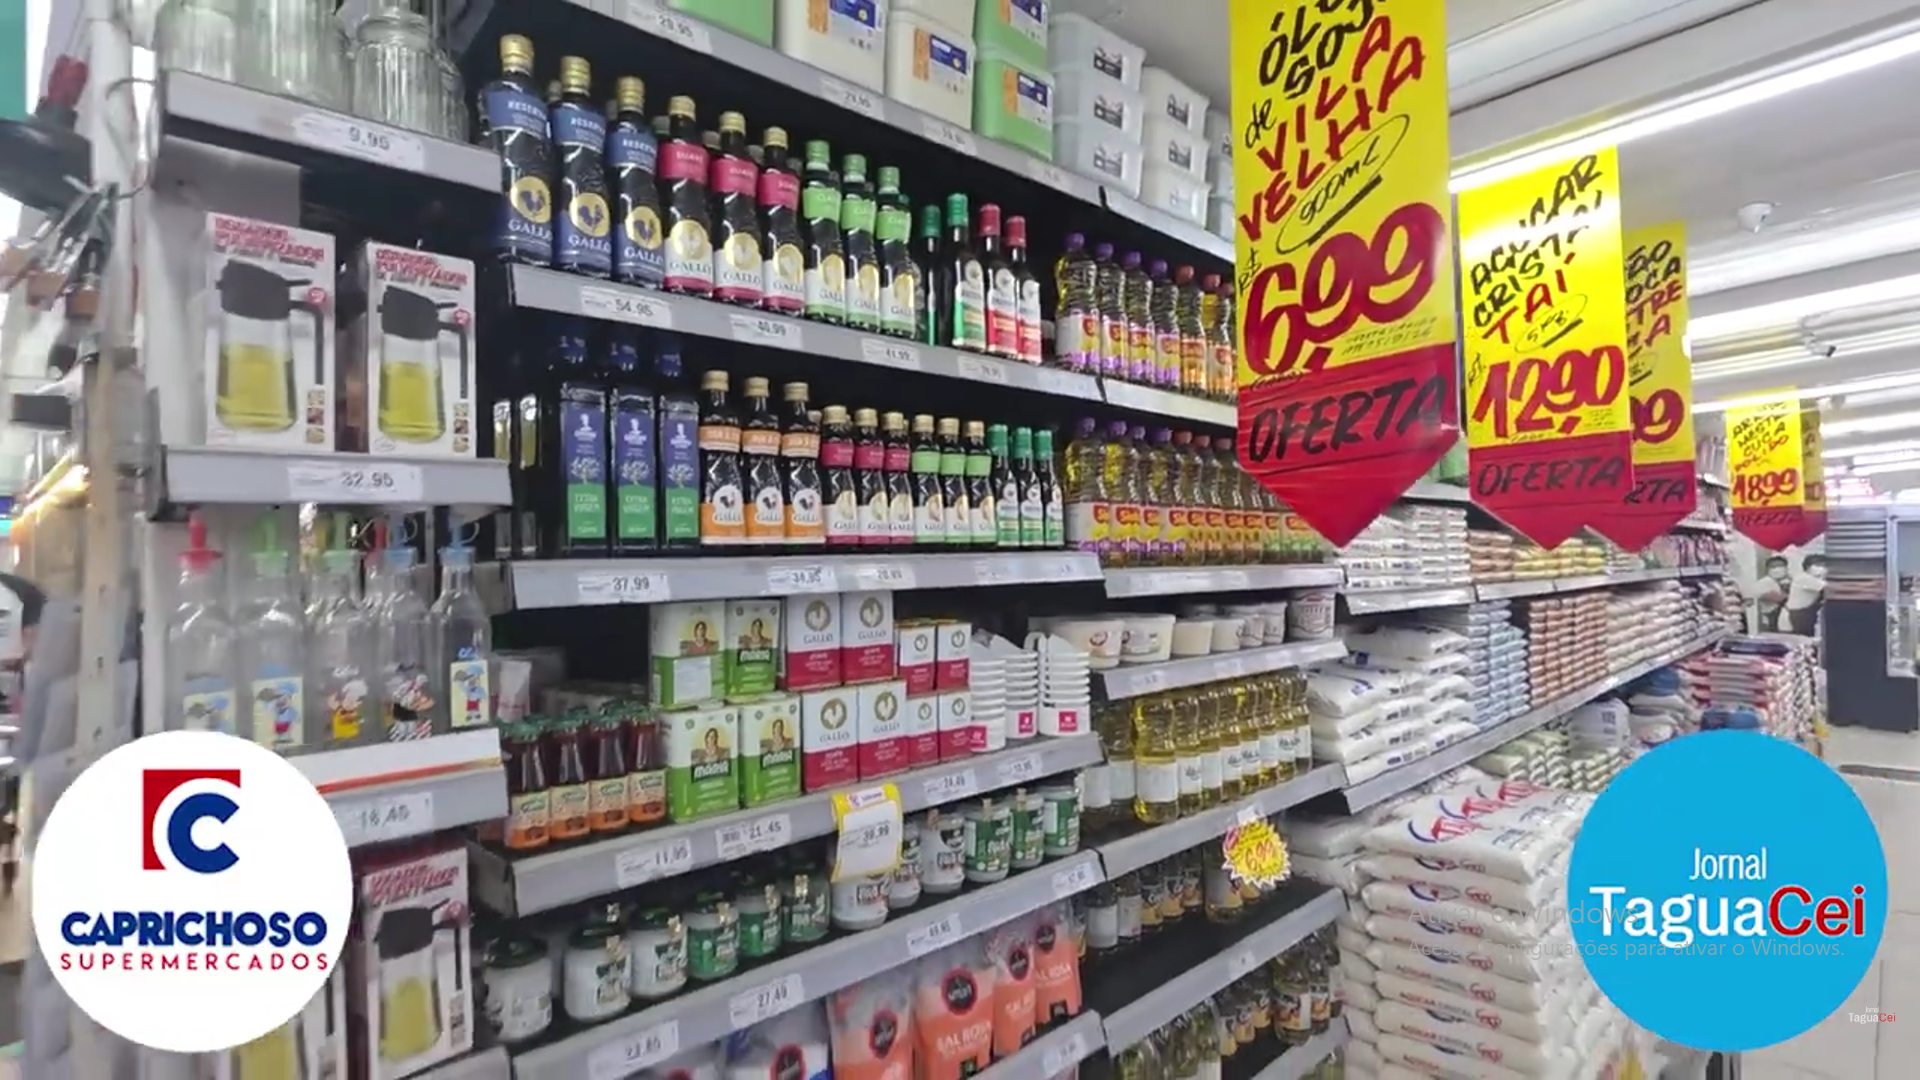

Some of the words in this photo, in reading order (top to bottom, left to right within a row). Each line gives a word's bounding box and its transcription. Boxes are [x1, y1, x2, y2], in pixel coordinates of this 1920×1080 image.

[1257, 16, 1391, 171] VILA
[1239, 36, 1426, 241] VELHA
[1249, 374, 1449, 465] OFERTA
[341, 471, 393, 489] 32.95
[1476, 455, 1626, 497] OFERTA
[613, 576, 650, 592] 37.99
[818, 731, 850, 744] GALLO
